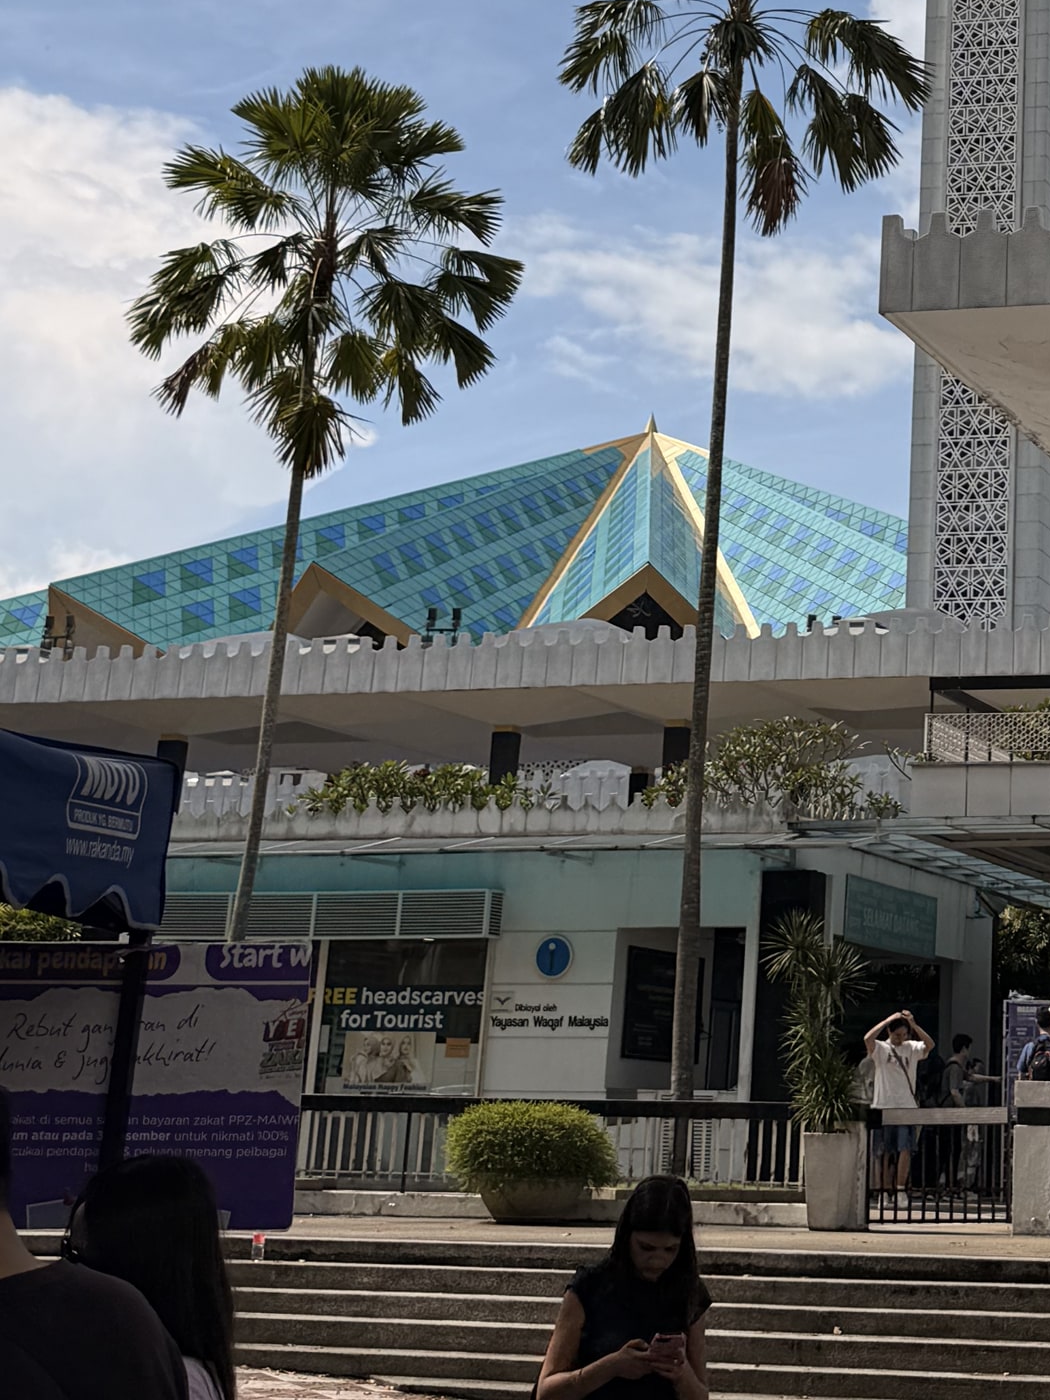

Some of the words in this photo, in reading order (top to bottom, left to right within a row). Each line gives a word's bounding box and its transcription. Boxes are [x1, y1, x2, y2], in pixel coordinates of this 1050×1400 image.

[219, 942, 283, 968] Start
[361, 987, 484, 1005] headscarves
[7, 1013, 77, 1040] Rebut
[340, 1010, 371, 1031] for
[374, 1009, 445, 1032] Tourist
[491, 1016, 529, 1031] Yayasan
[533, 1016, 564, 1031] Waqaf
[568, 1016, 609, 1031] Malaysia
[54, 1117, 93, 1126] semua
[142, 1115, 190, 1128] bayaran
[193, 1115, 225, 1126] zakat
[31, 1130, 59, 1141] atau
[62, 1130, 93, 1142] pada
[174, 1131, 207, 1142] untuk
[211, 1131, 254, 1142] nikmati
[185, 1147, 232, 1159] menang
[235, 1146, 287, 1159] pelbagai
